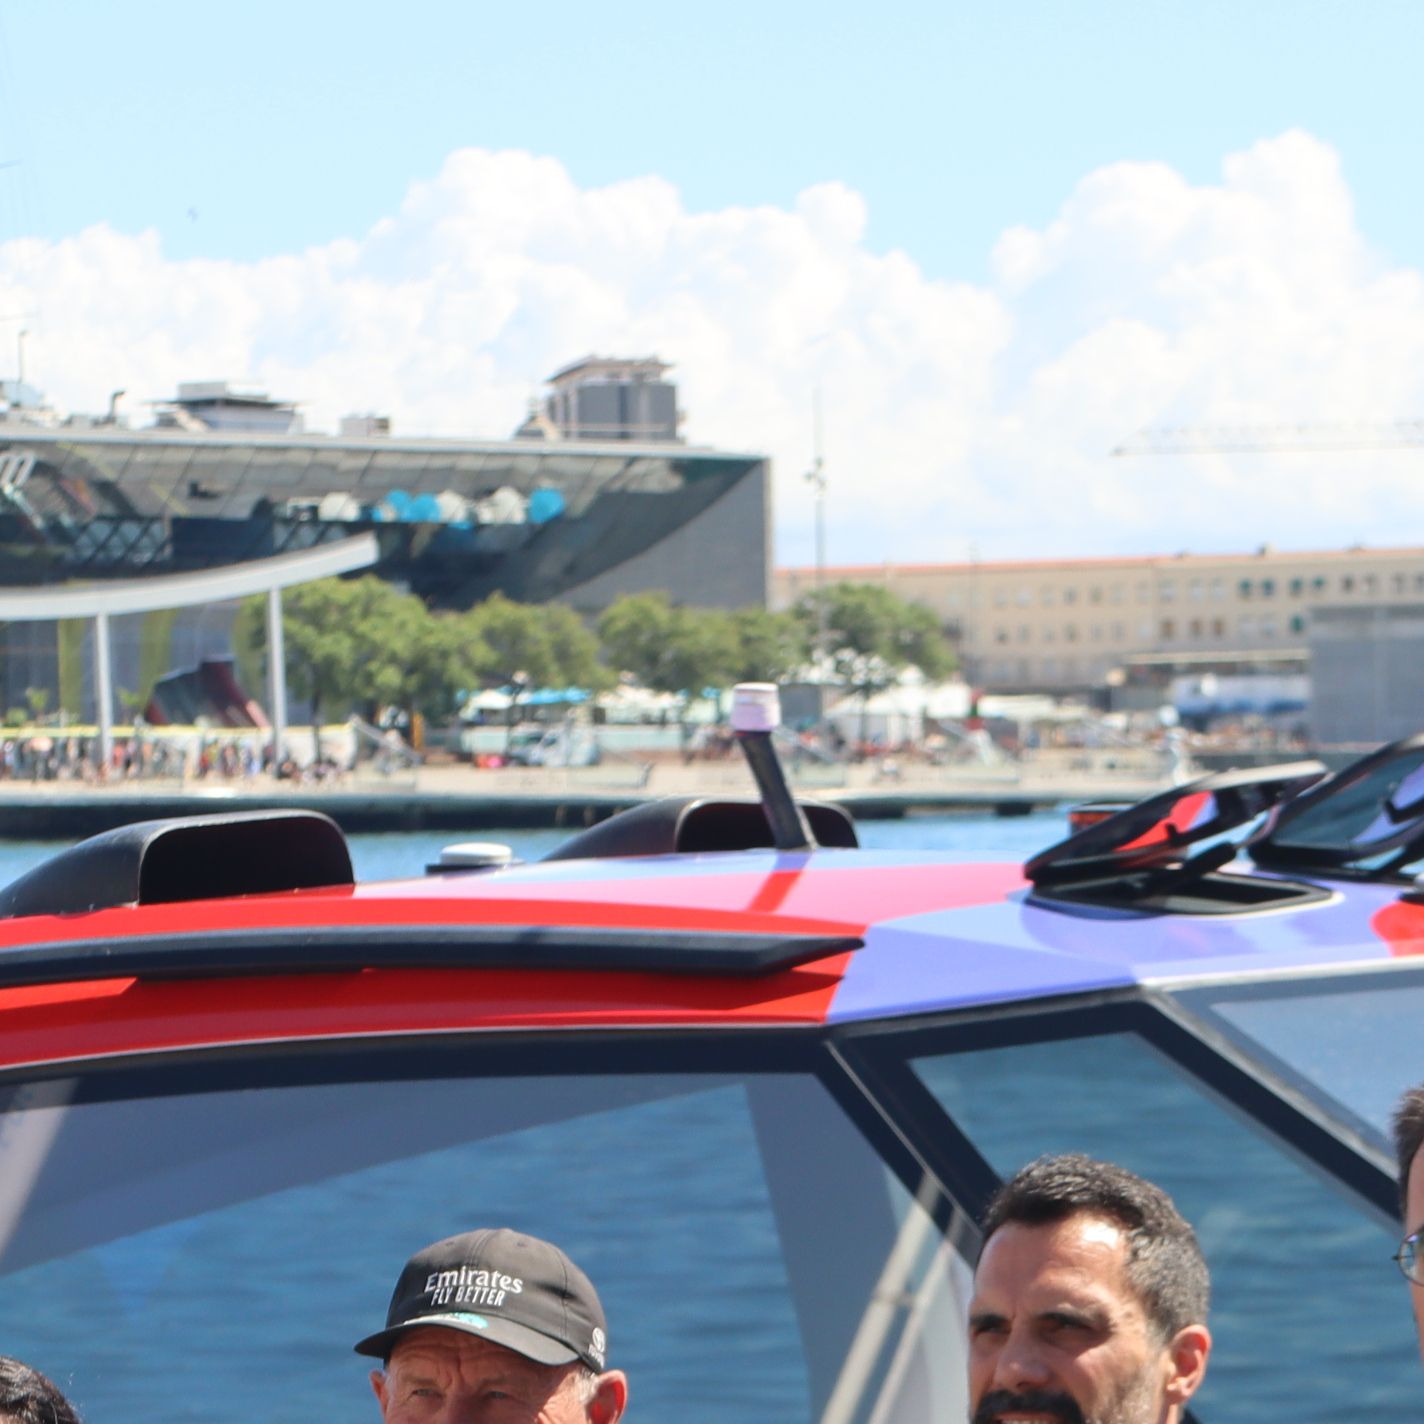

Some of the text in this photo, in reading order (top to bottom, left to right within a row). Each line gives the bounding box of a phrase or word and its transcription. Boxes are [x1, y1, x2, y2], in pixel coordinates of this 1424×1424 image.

[424, 1265, 524, 1294] Emirates
[431, 1286, 506, 1307] FLY BETTER
